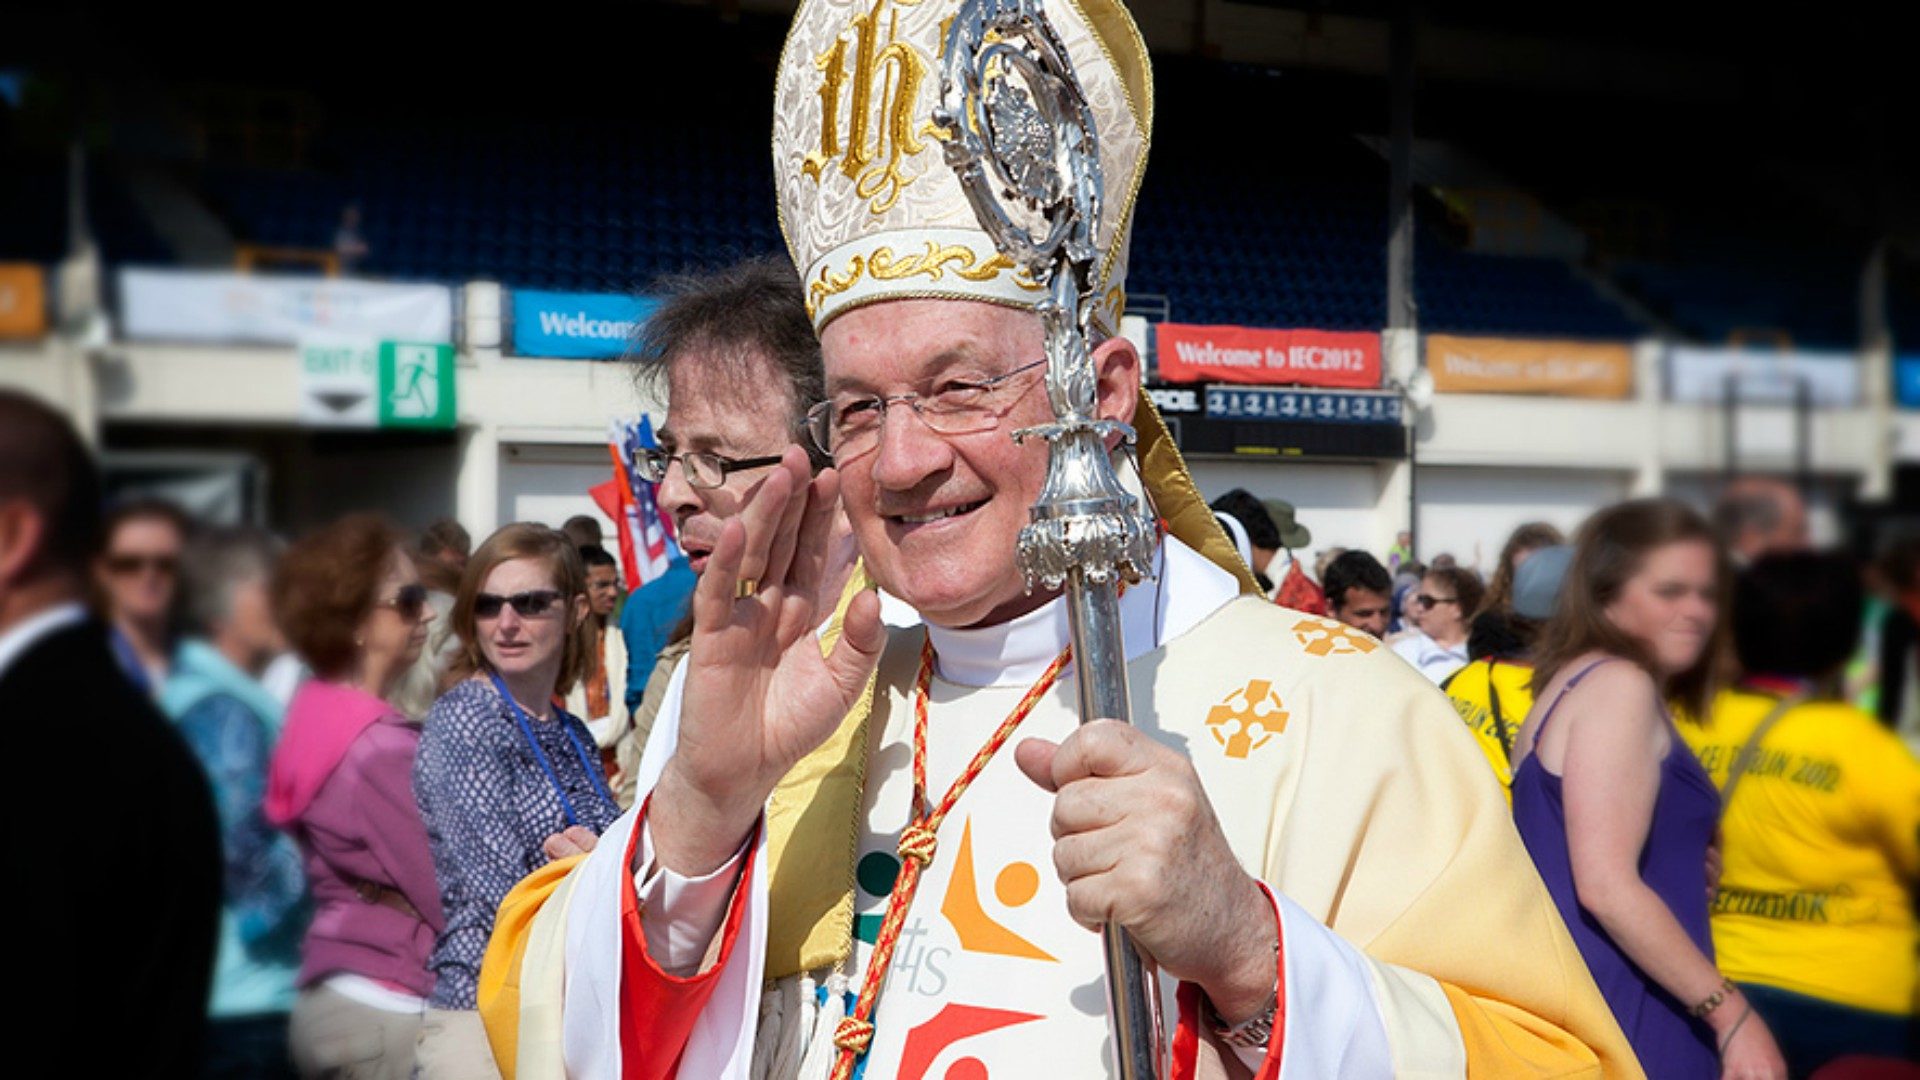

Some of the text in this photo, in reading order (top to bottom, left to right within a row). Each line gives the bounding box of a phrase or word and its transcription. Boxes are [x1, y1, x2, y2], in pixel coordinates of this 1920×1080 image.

[1175, 340, 1364, 371] Welcome to IEC2012
